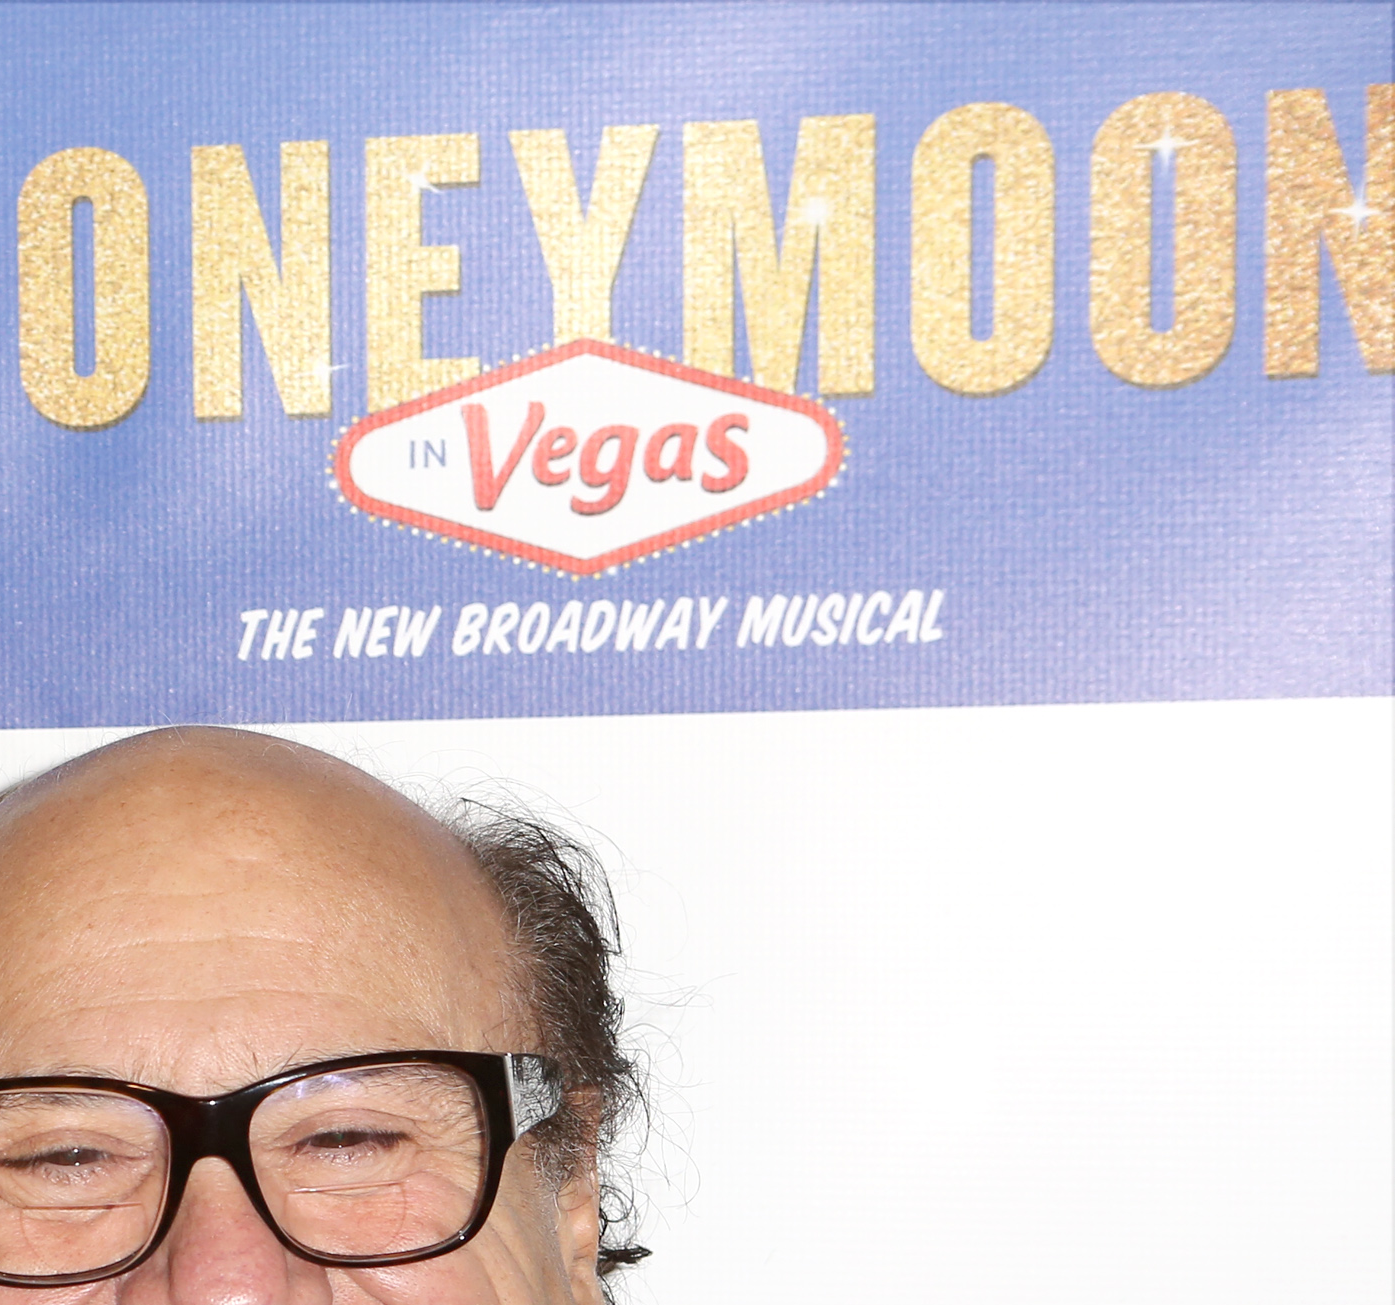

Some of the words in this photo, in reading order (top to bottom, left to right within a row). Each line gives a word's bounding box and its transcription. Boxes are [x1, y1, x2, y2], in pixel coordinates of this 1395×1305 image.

[409, 438, 447, 469] IN
[460, 401, 750, 516] Vegas
[238, 608, 324, 660] THE
[334, 604, 441, 658] NEW
[451, 597, 728, 655] BROADWAY
[737, 590, 946, 649] MUSICAL
